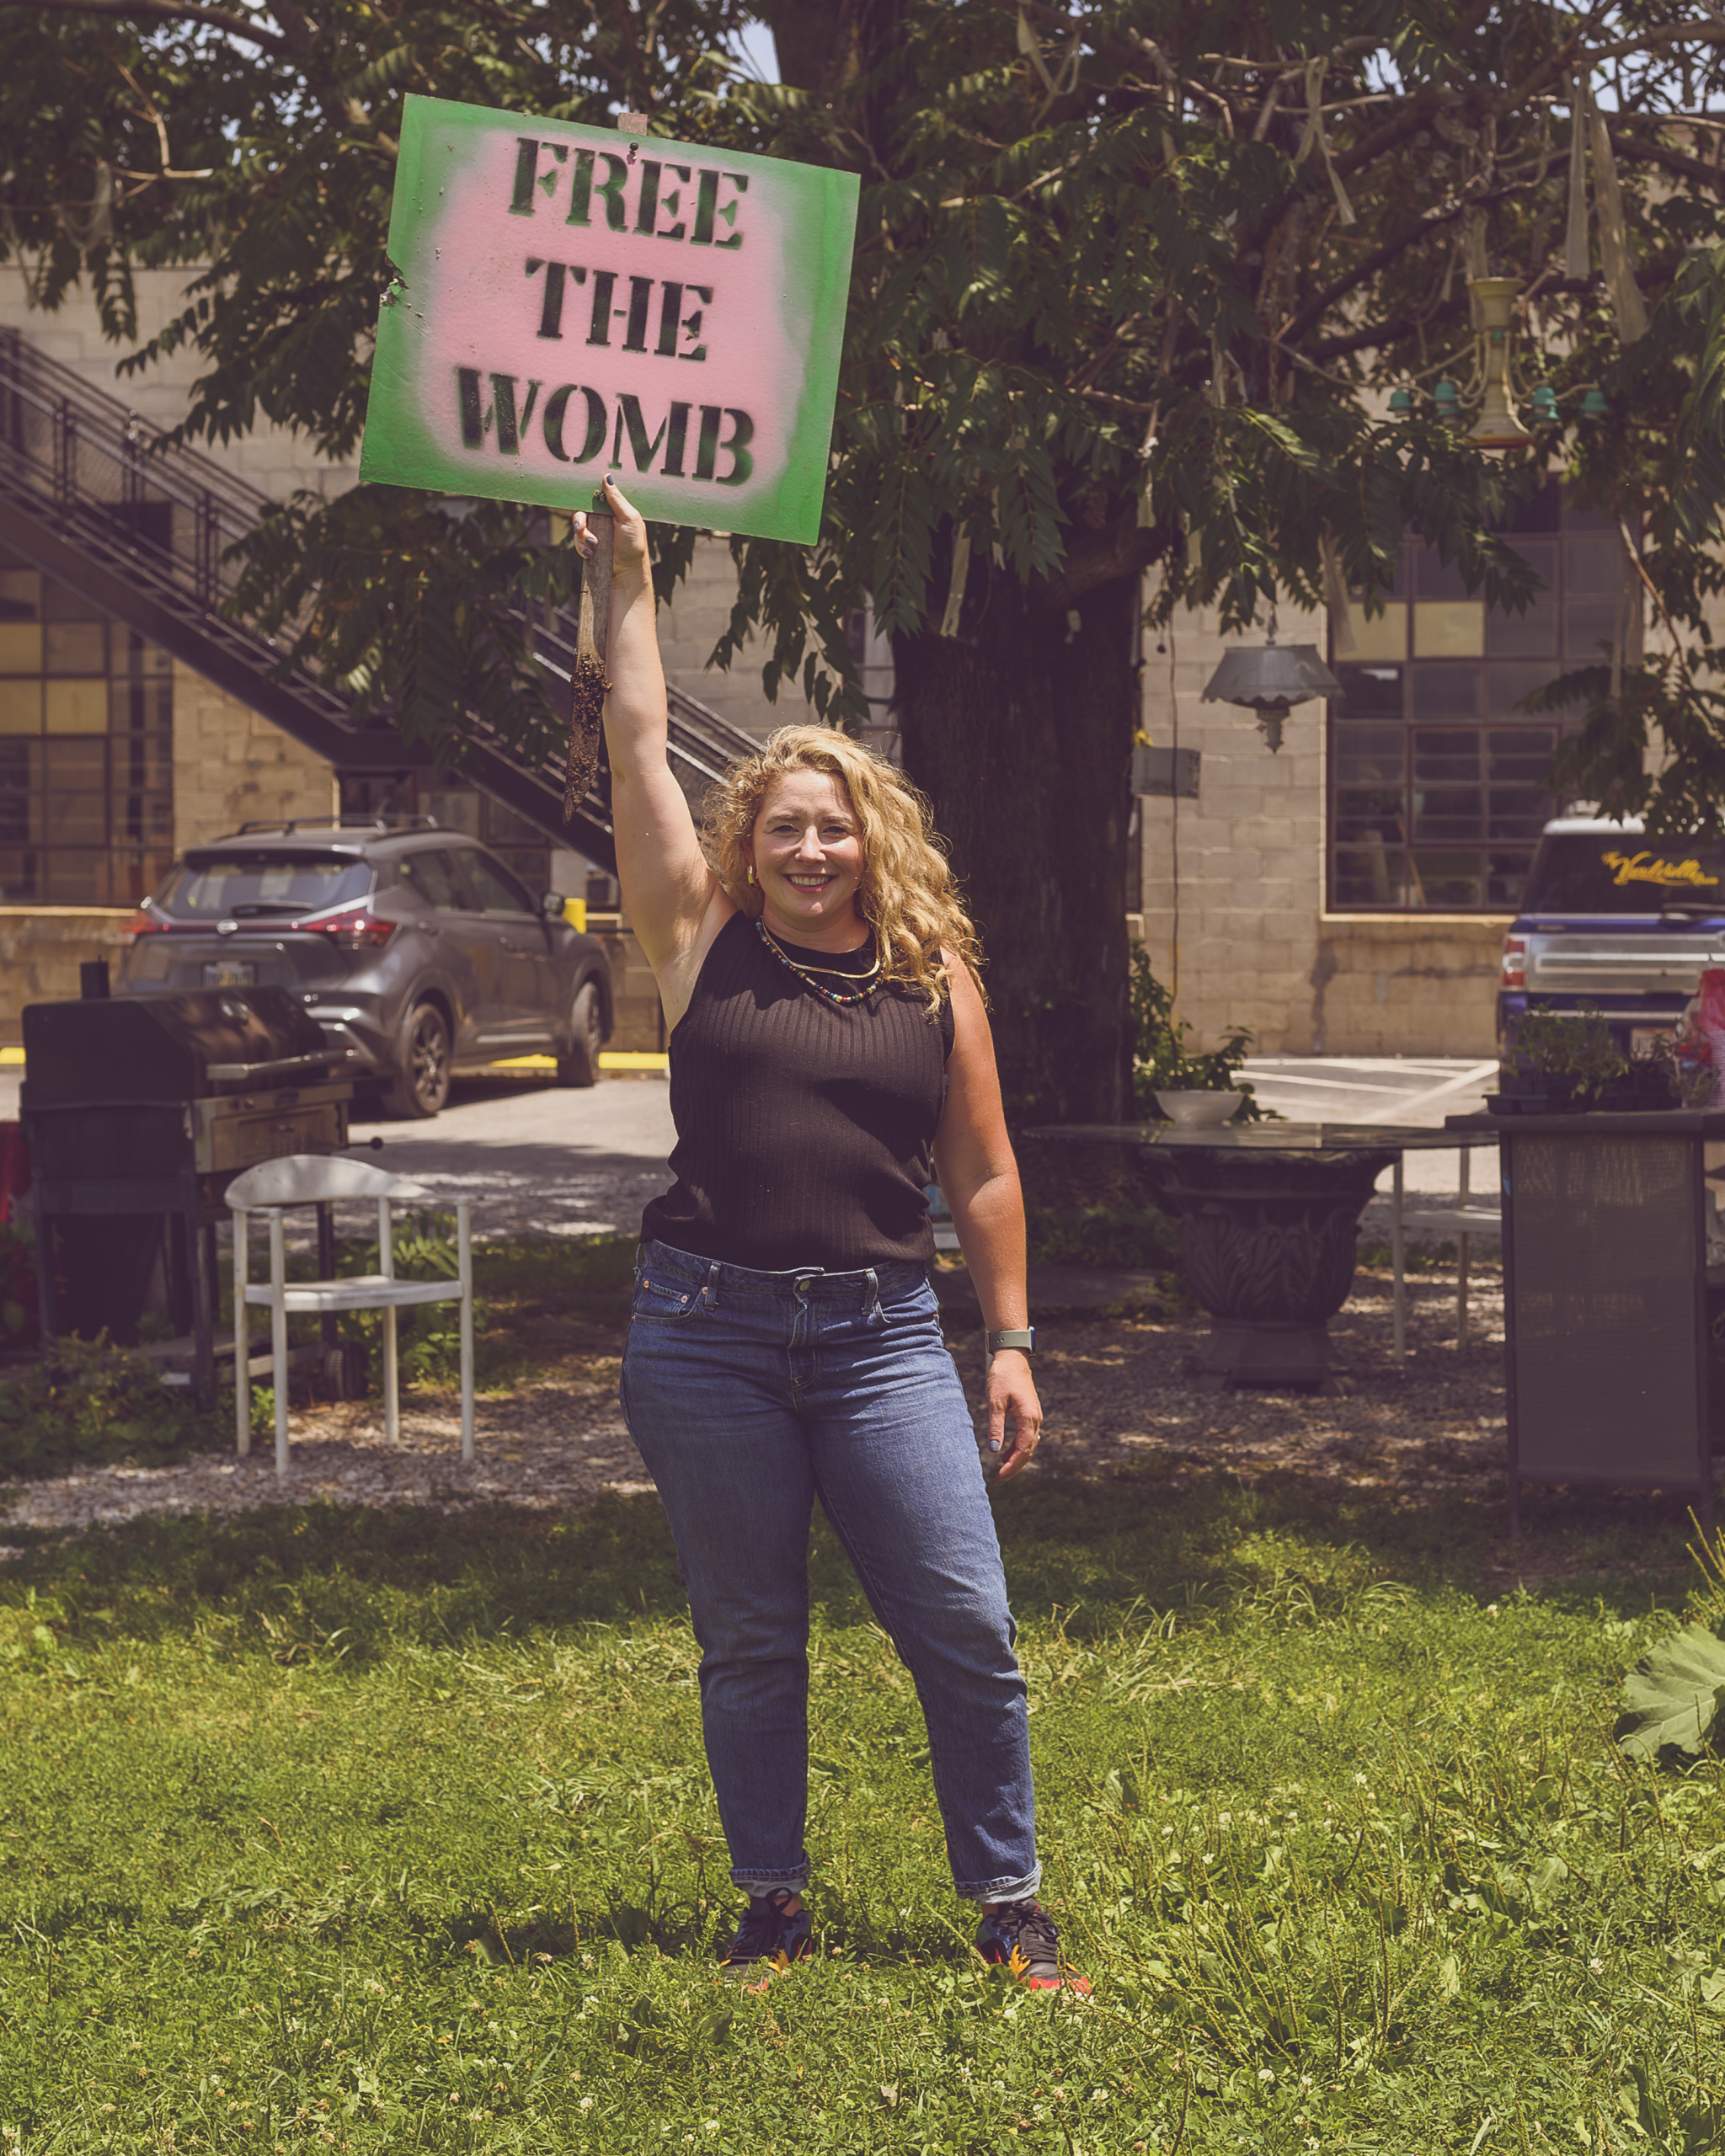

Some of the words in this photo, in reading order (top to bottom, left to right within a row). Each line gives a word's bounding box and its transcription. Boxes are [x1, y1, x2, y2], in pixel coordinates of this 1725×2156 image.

[508, 136, 749, 250] FREE
[525, 258, 713, 362] THE
[455, 366, 755, 487] WOMB
